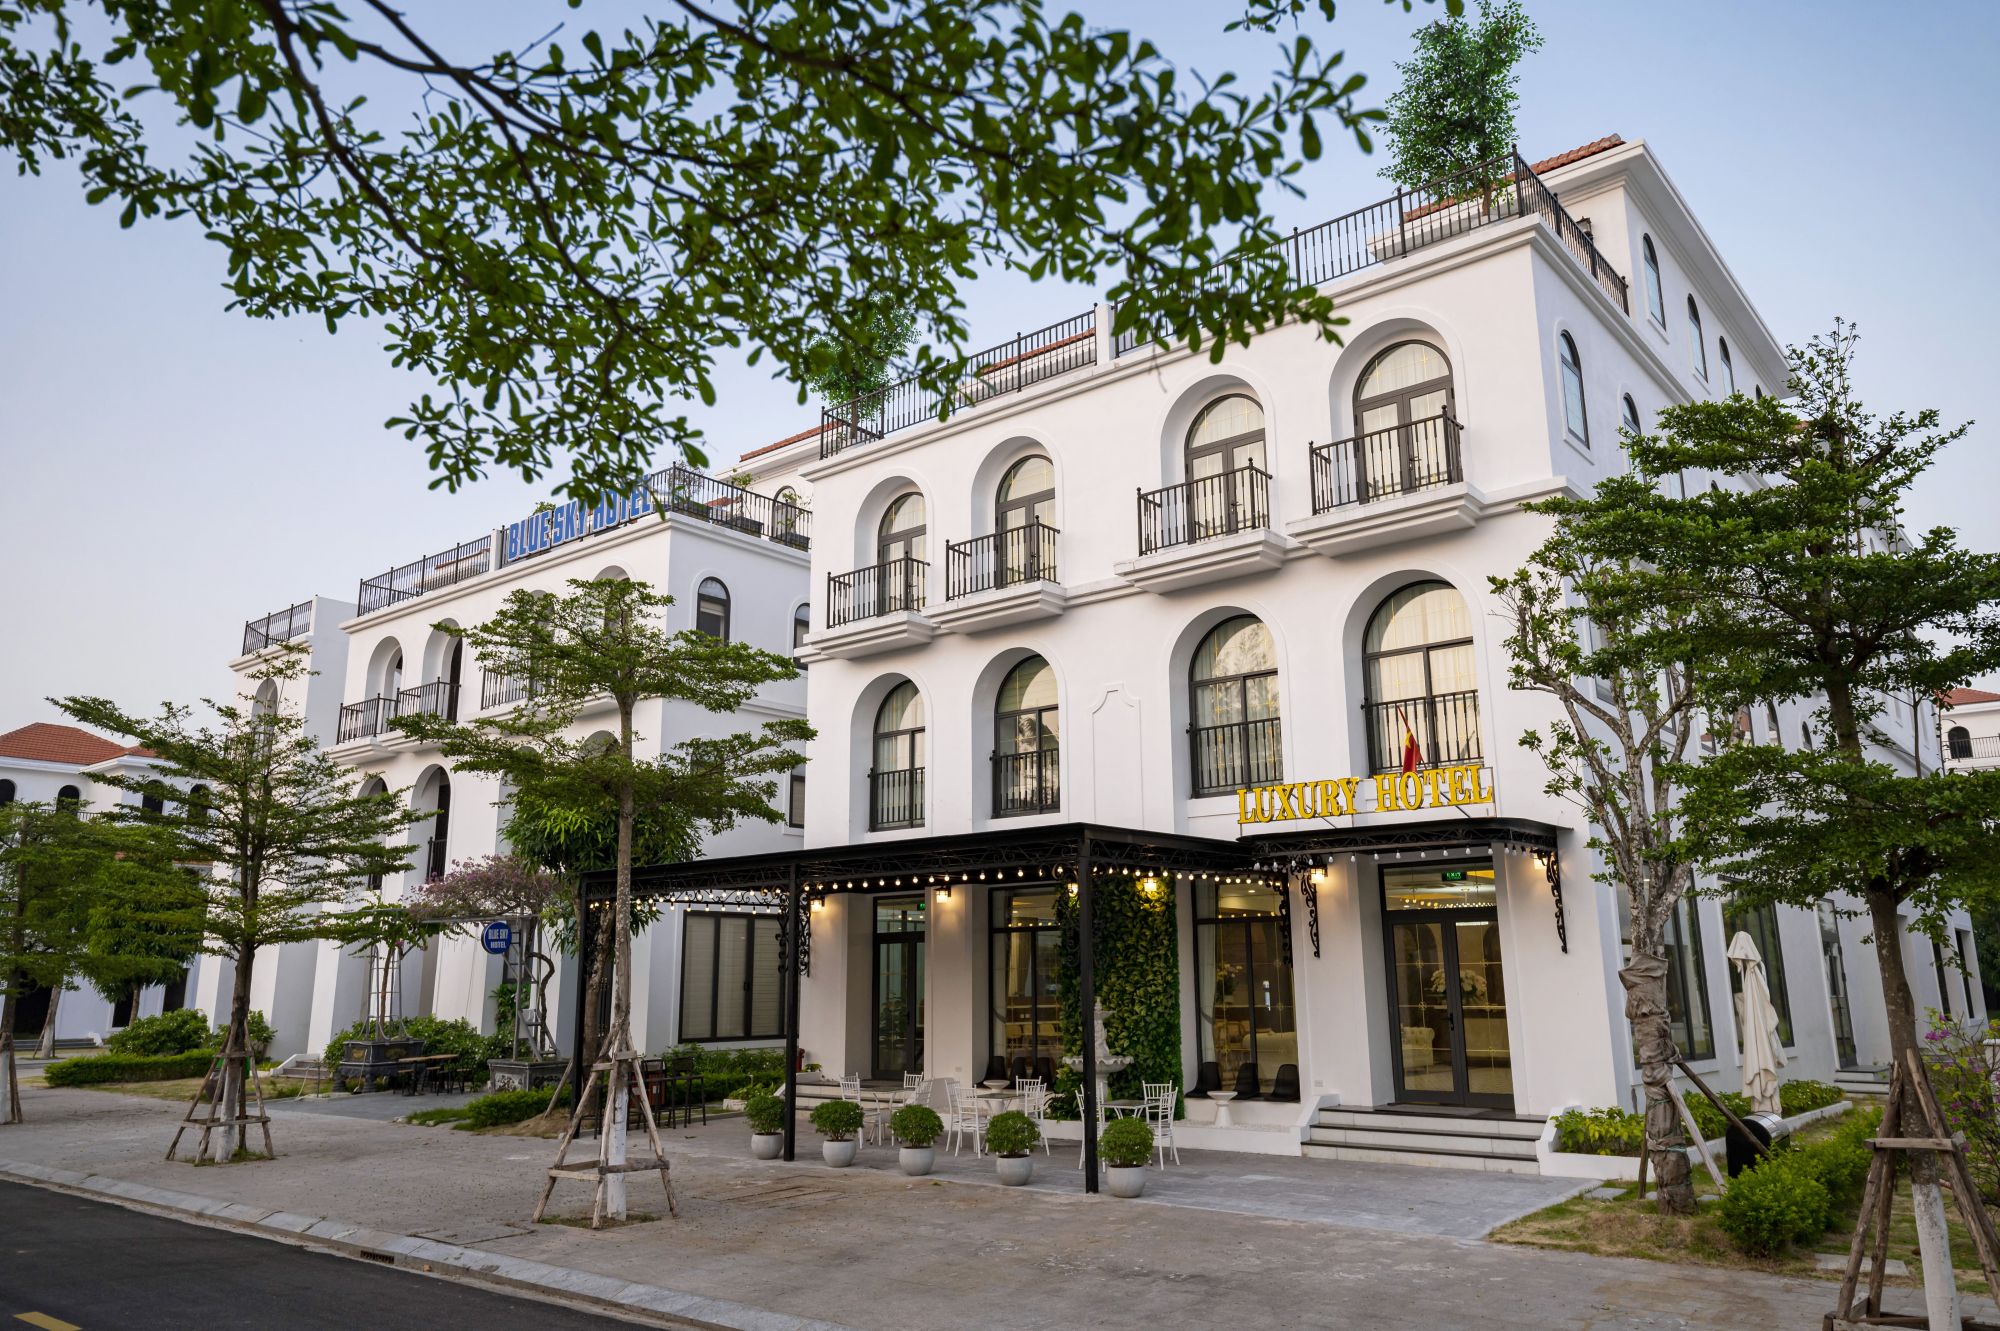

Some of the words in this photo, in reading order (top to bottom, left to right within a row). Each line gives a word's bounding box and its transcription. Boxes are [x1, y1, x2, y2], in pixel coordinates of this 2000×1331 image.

[508, 510, 551, 561] BLUE
[551, 498, 587, 547] SKY
[1237, 777, 1359, 824] LUXURY
[1373, 764, 1493, 812] HOTEL
[488, 928, 499, 940] BLUE
[500, 928, 508, 940] SKY
